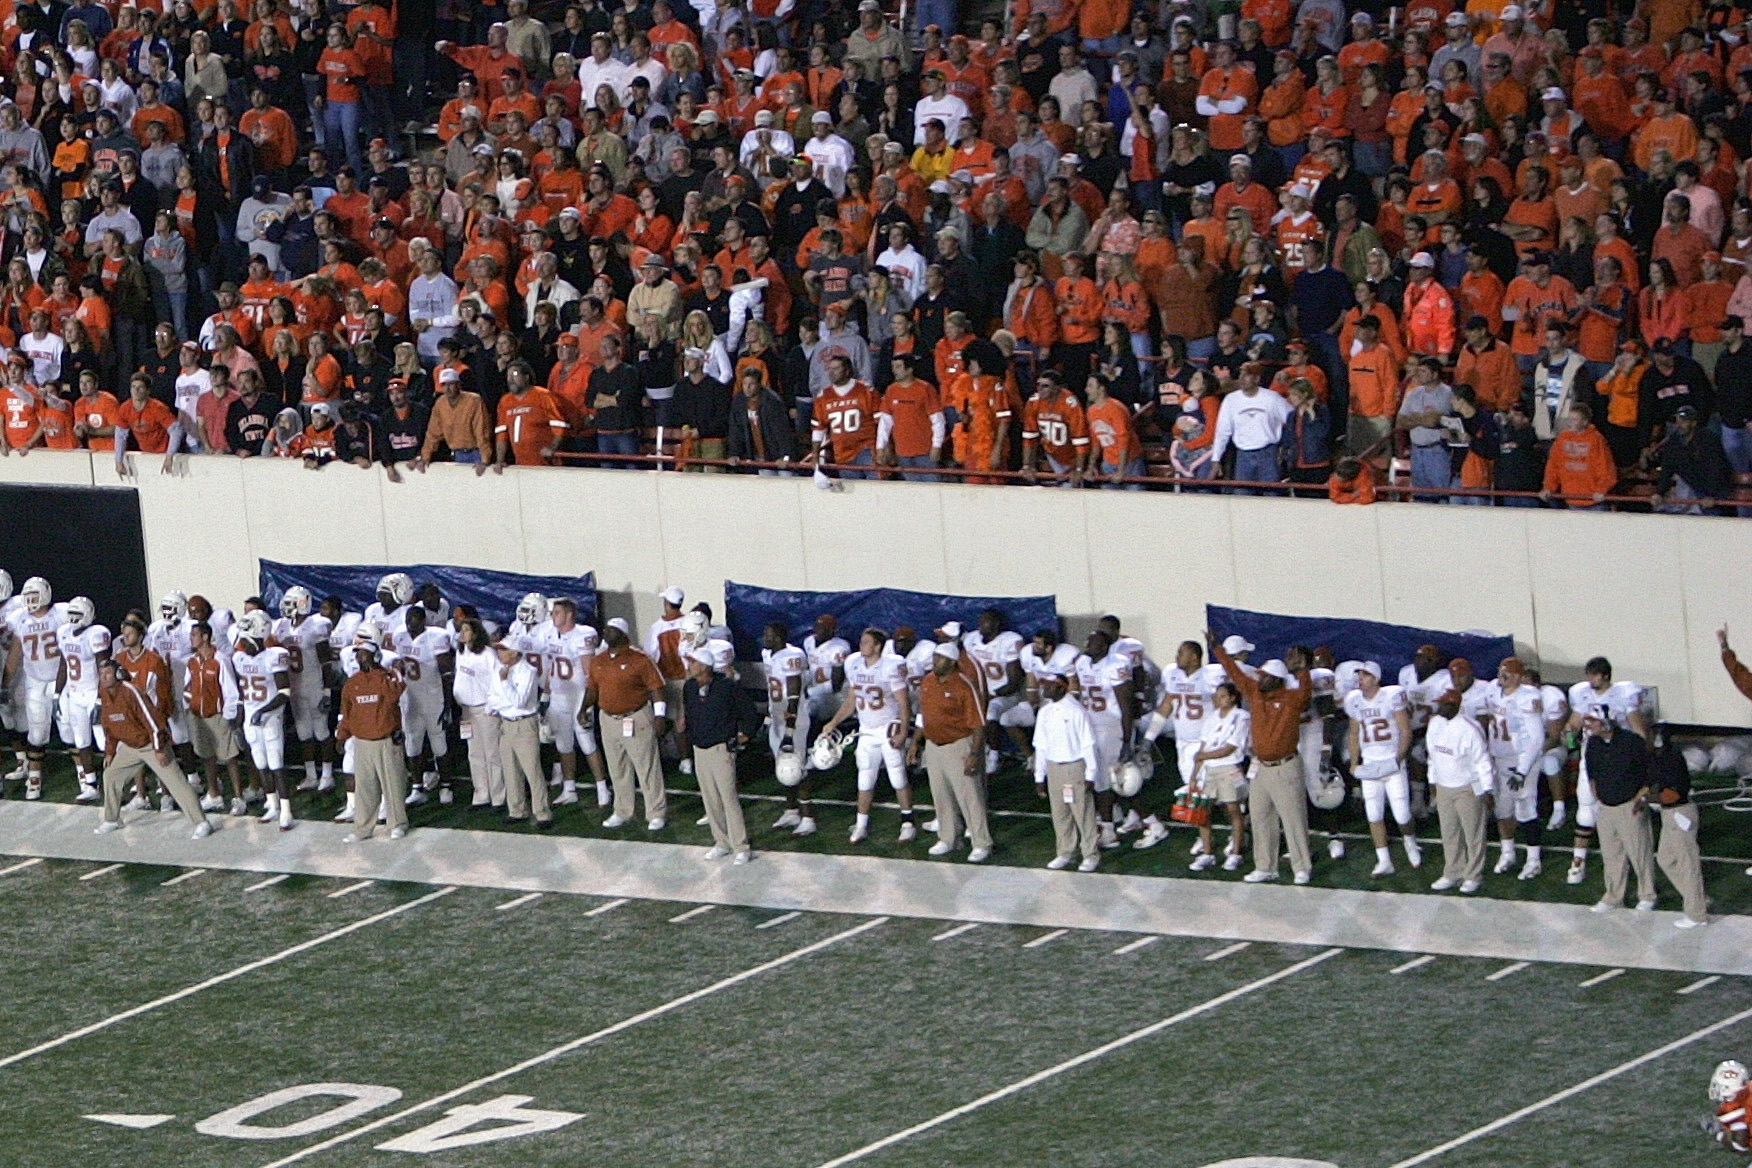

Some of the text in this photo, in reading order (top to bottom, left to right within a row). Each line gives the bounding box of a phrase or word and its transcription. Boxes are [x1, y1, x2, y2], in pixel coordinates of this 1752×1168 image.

[514, 415, 521, 443] 1
[828, 408, 860, 434] 20
[28, 621, 49, 633] TEXAS
[23, 632, 61, 661] 72
[67, 654, 82, 681] 9
[239, 675, 268, 702] 25
[356, 695, 378, 704] TEXAS
[1167, 693, 1204, 720] 75
[1361, 707, 1380, 718] TEXAS
[1359, 718, 1392, 743] 12
[195, 1082, 587, 1154] 40
